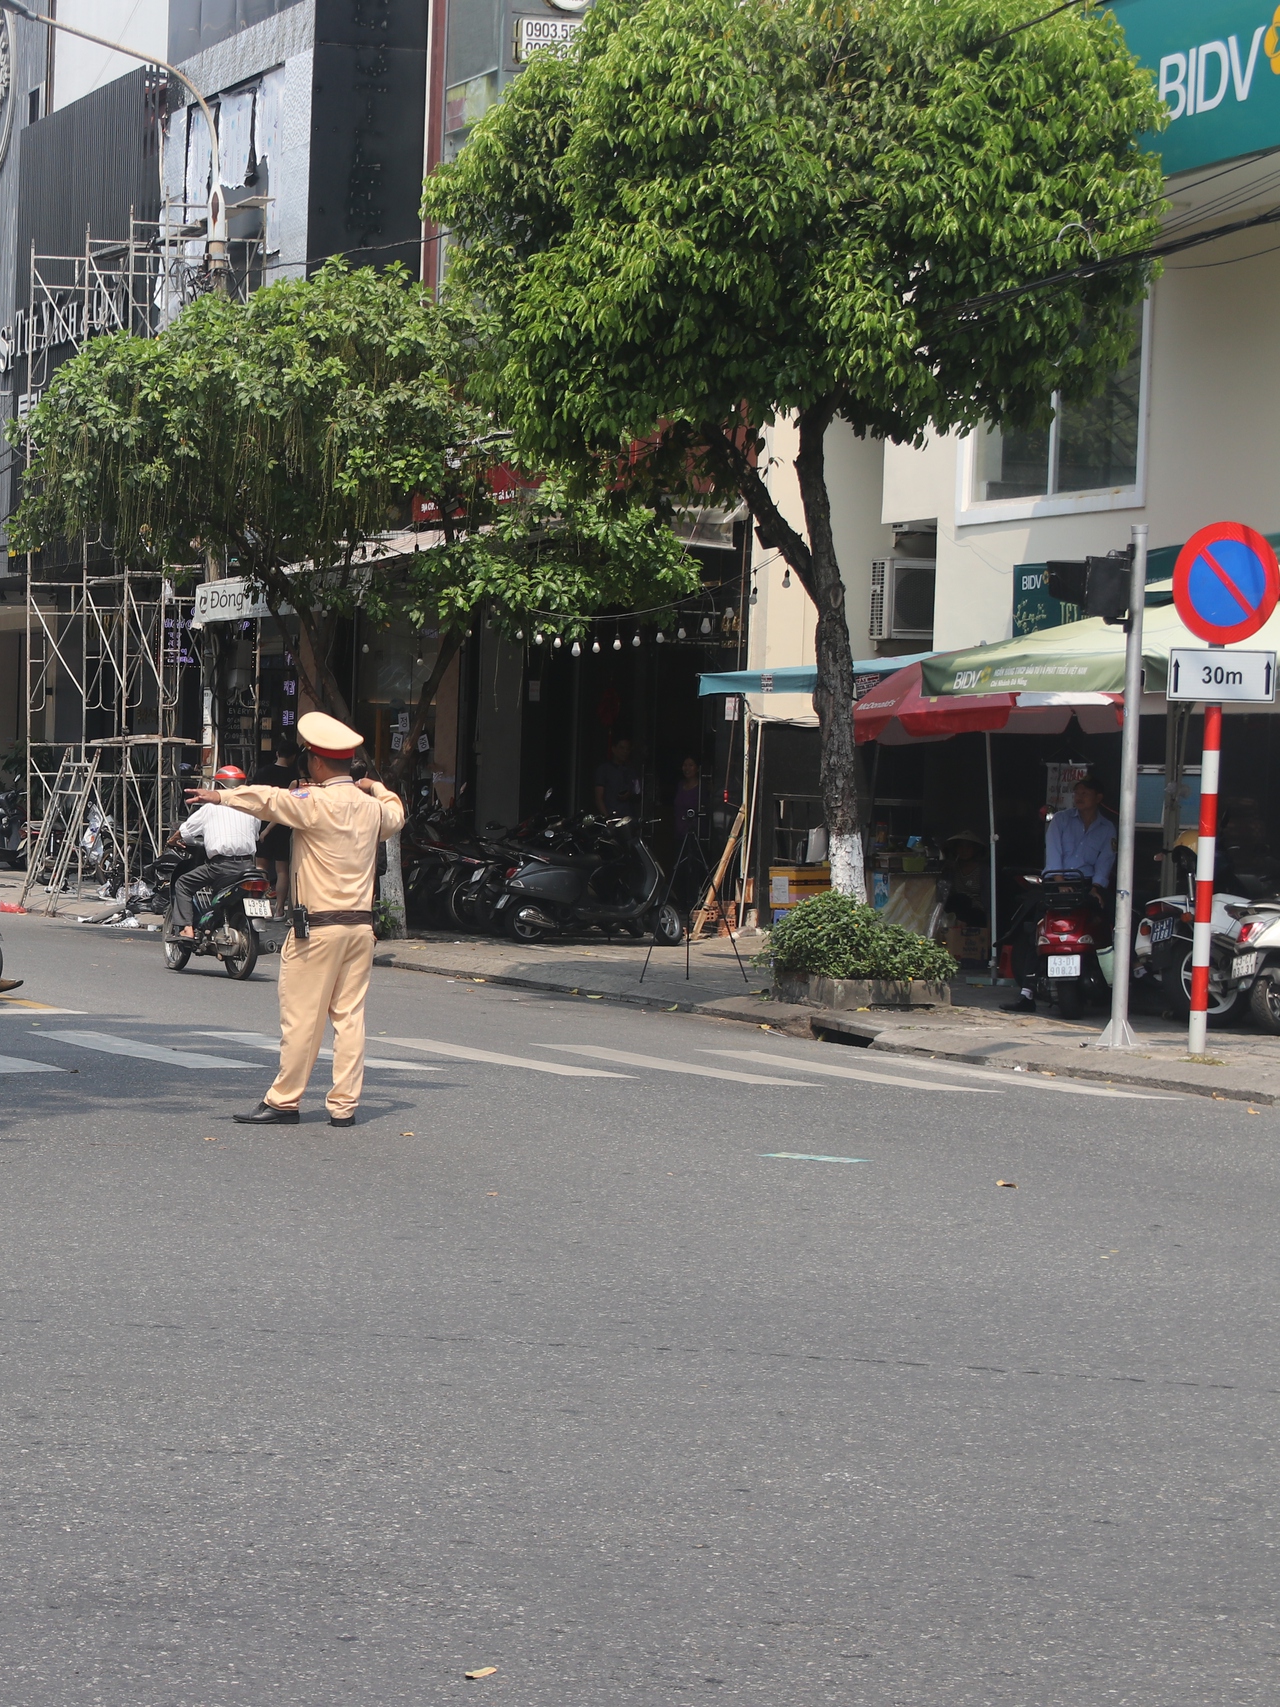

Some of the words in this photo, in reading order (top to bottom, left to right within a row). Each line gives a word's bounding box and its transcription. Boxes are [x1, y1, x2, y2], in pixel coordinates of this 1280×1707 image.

[1158, 24, 1267, 121] BIDV
[1021, 573, 1043, 591] BIDV
[210, 590, 244, 612] Đông
[953, 669, 982, 690] BIDV
[1201, 666, 1243, 685] 30m
